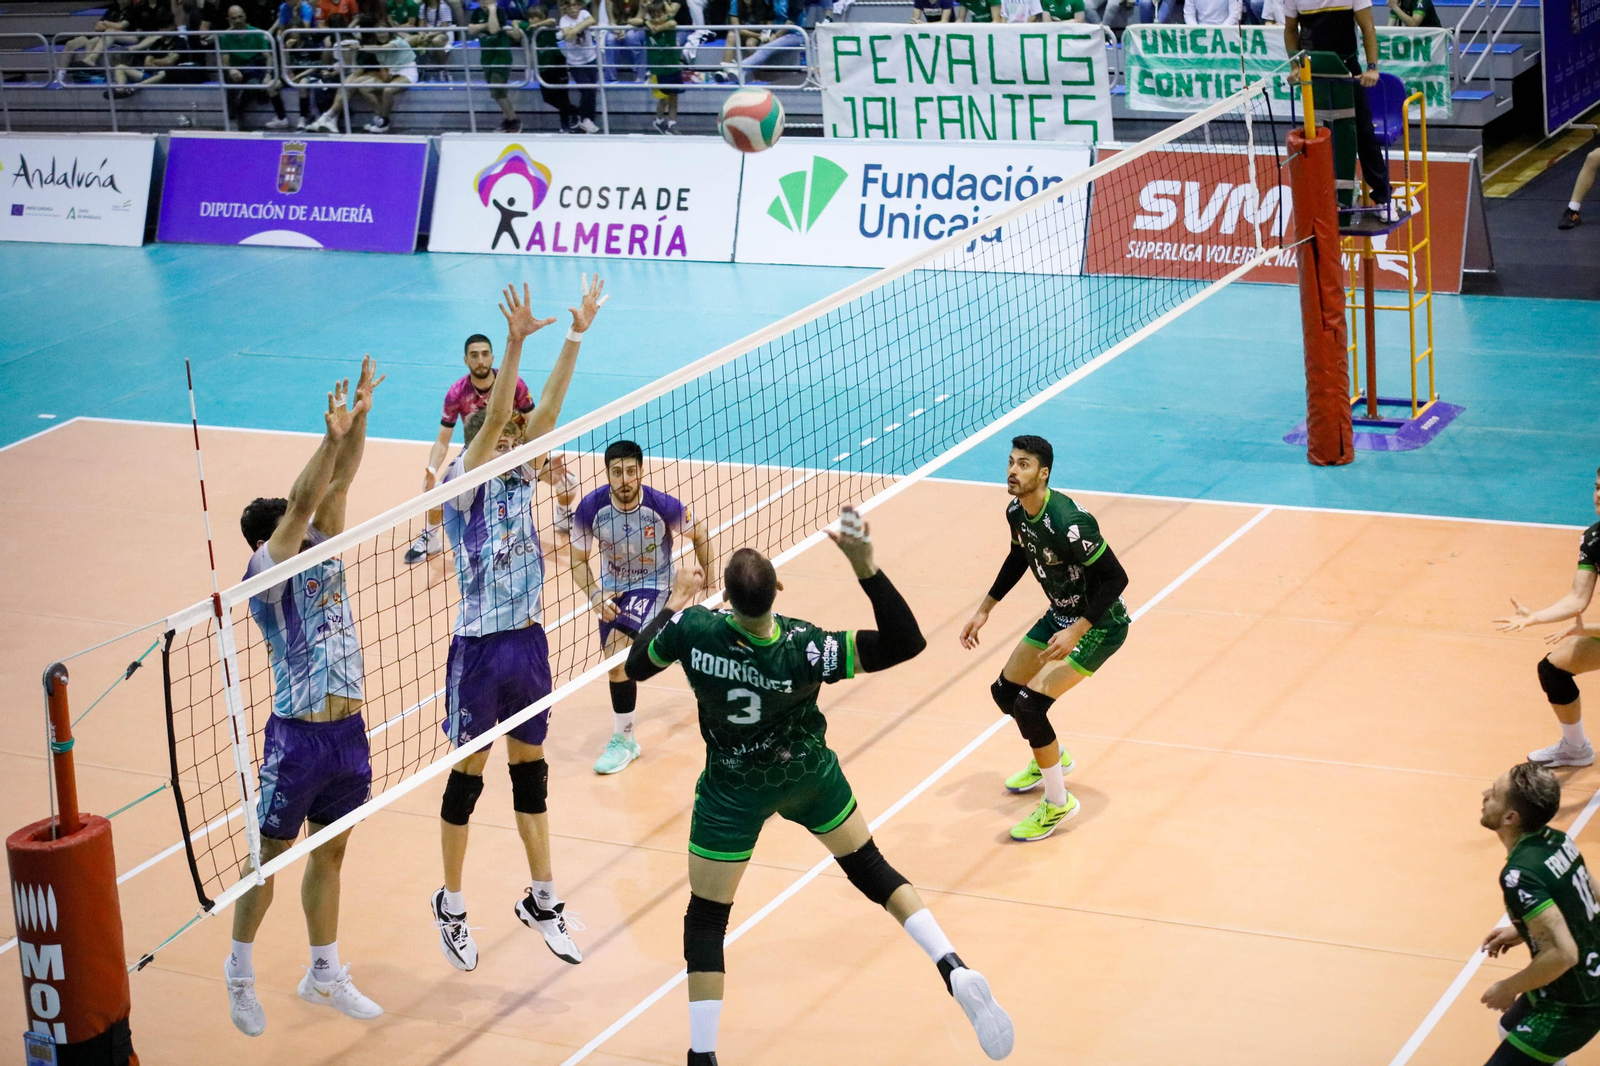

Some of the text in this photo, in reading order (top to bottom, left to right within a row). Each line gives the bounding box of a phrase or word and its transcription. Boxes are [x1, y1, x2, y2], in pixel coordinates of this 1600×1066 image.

[12, 153, 122, 194] Andalucía
[862, 163, 1065, 203] Fundación
[200, 201, 374, 223] DIPUTACIÓN DE ALMERÍA
[559, 186, 691, 211] COSTA DE
[526, 215, 687, 257] ALMERÍA
[1126, 240, 1202, 263] SUPERLIGA
[691, 648, 793, 694] RODRÍGUEZ
[727, 688, 761, 725] 3
